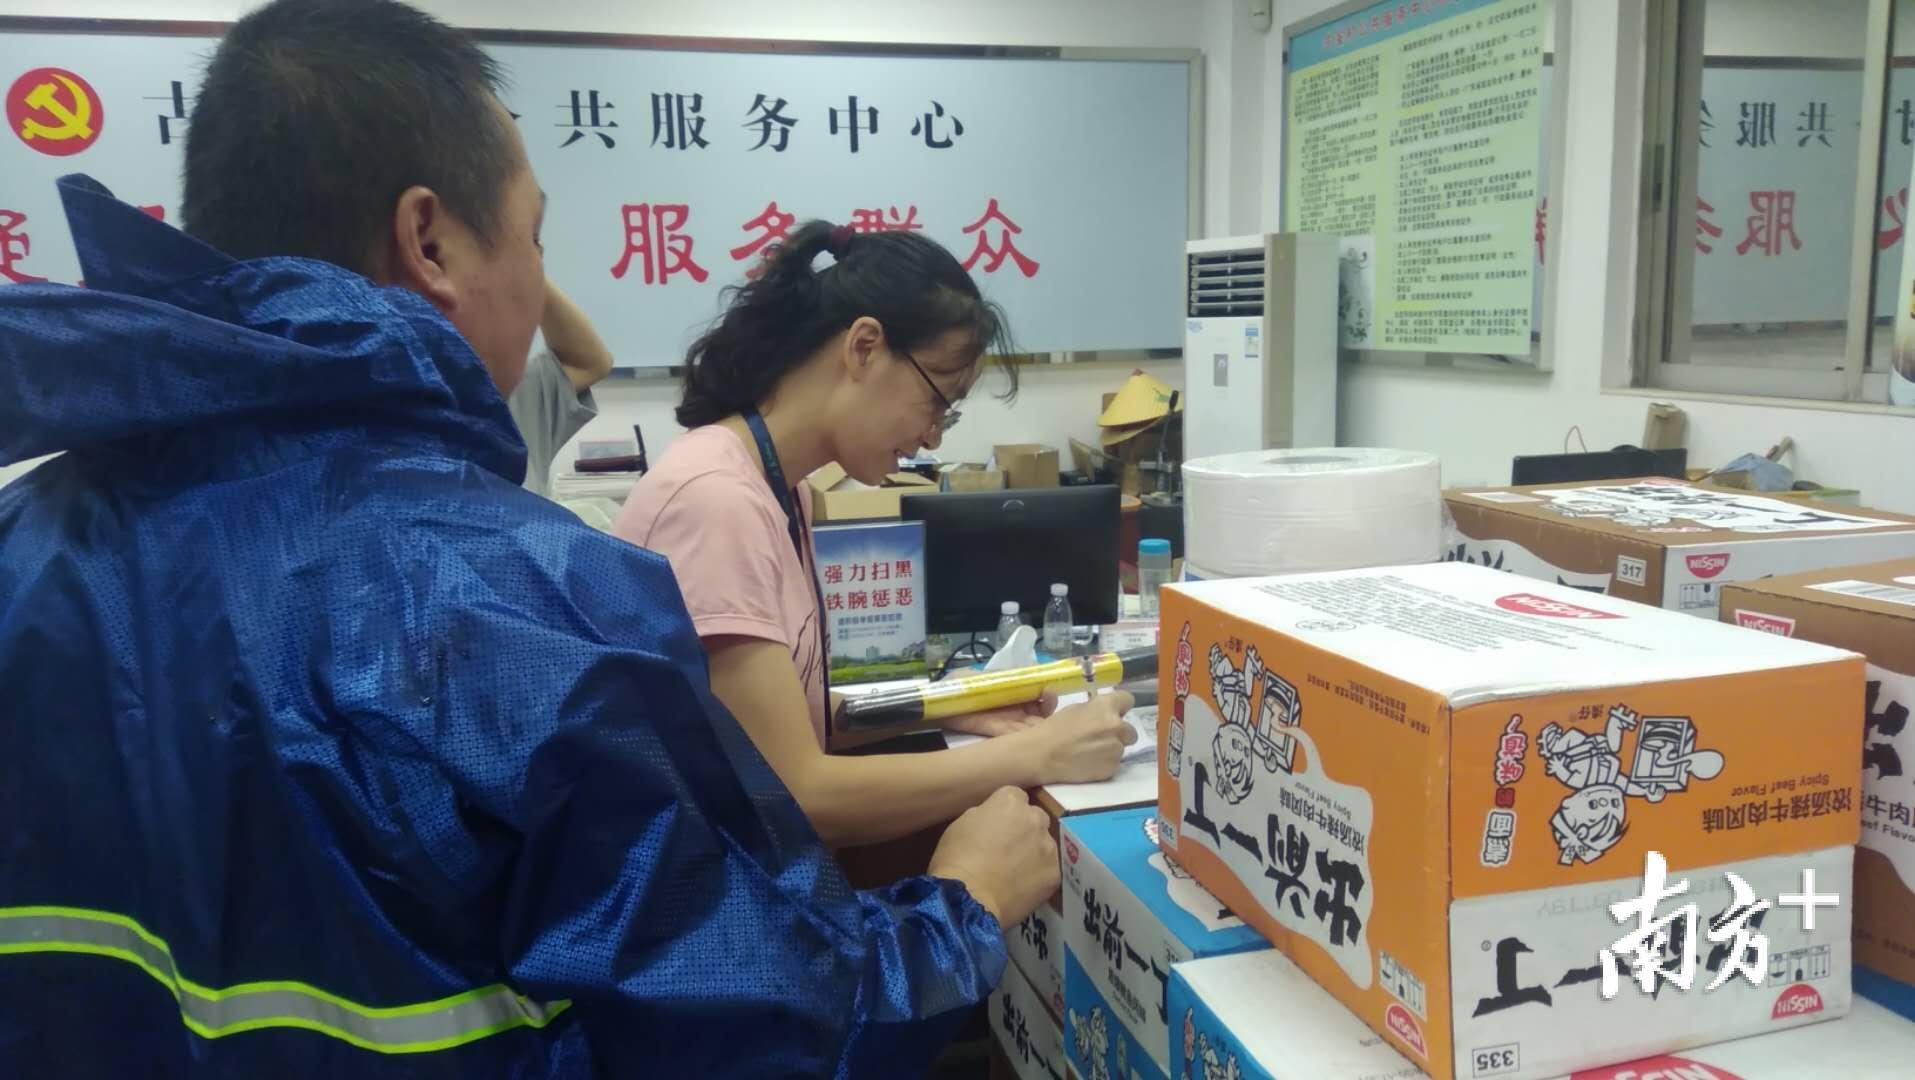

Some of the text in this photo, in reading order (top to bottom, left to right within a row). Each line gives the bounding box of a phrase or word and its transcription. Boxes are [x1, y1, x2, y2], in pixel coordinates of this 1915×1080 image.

[555, 88, 966, 154] 共服务中心
[825, 559, 913, 584] 强力扫黑
[1621, 563, 1643, 579] 317
[1689, 555, 1727, 572] NISSIN
[825, 587, 913, 611] 铁腕惩恶
[1731, 774, 1830, 797] Spicy Beef Flavor
[1702, 786, 1853, 834] 浓汤辣牛肉风味
[1184, 762, 1366, 946] 出前一丁
[1777, 994, 1820, 1016] NISSIN
[1475, 1050, 1516, 1072] 335
